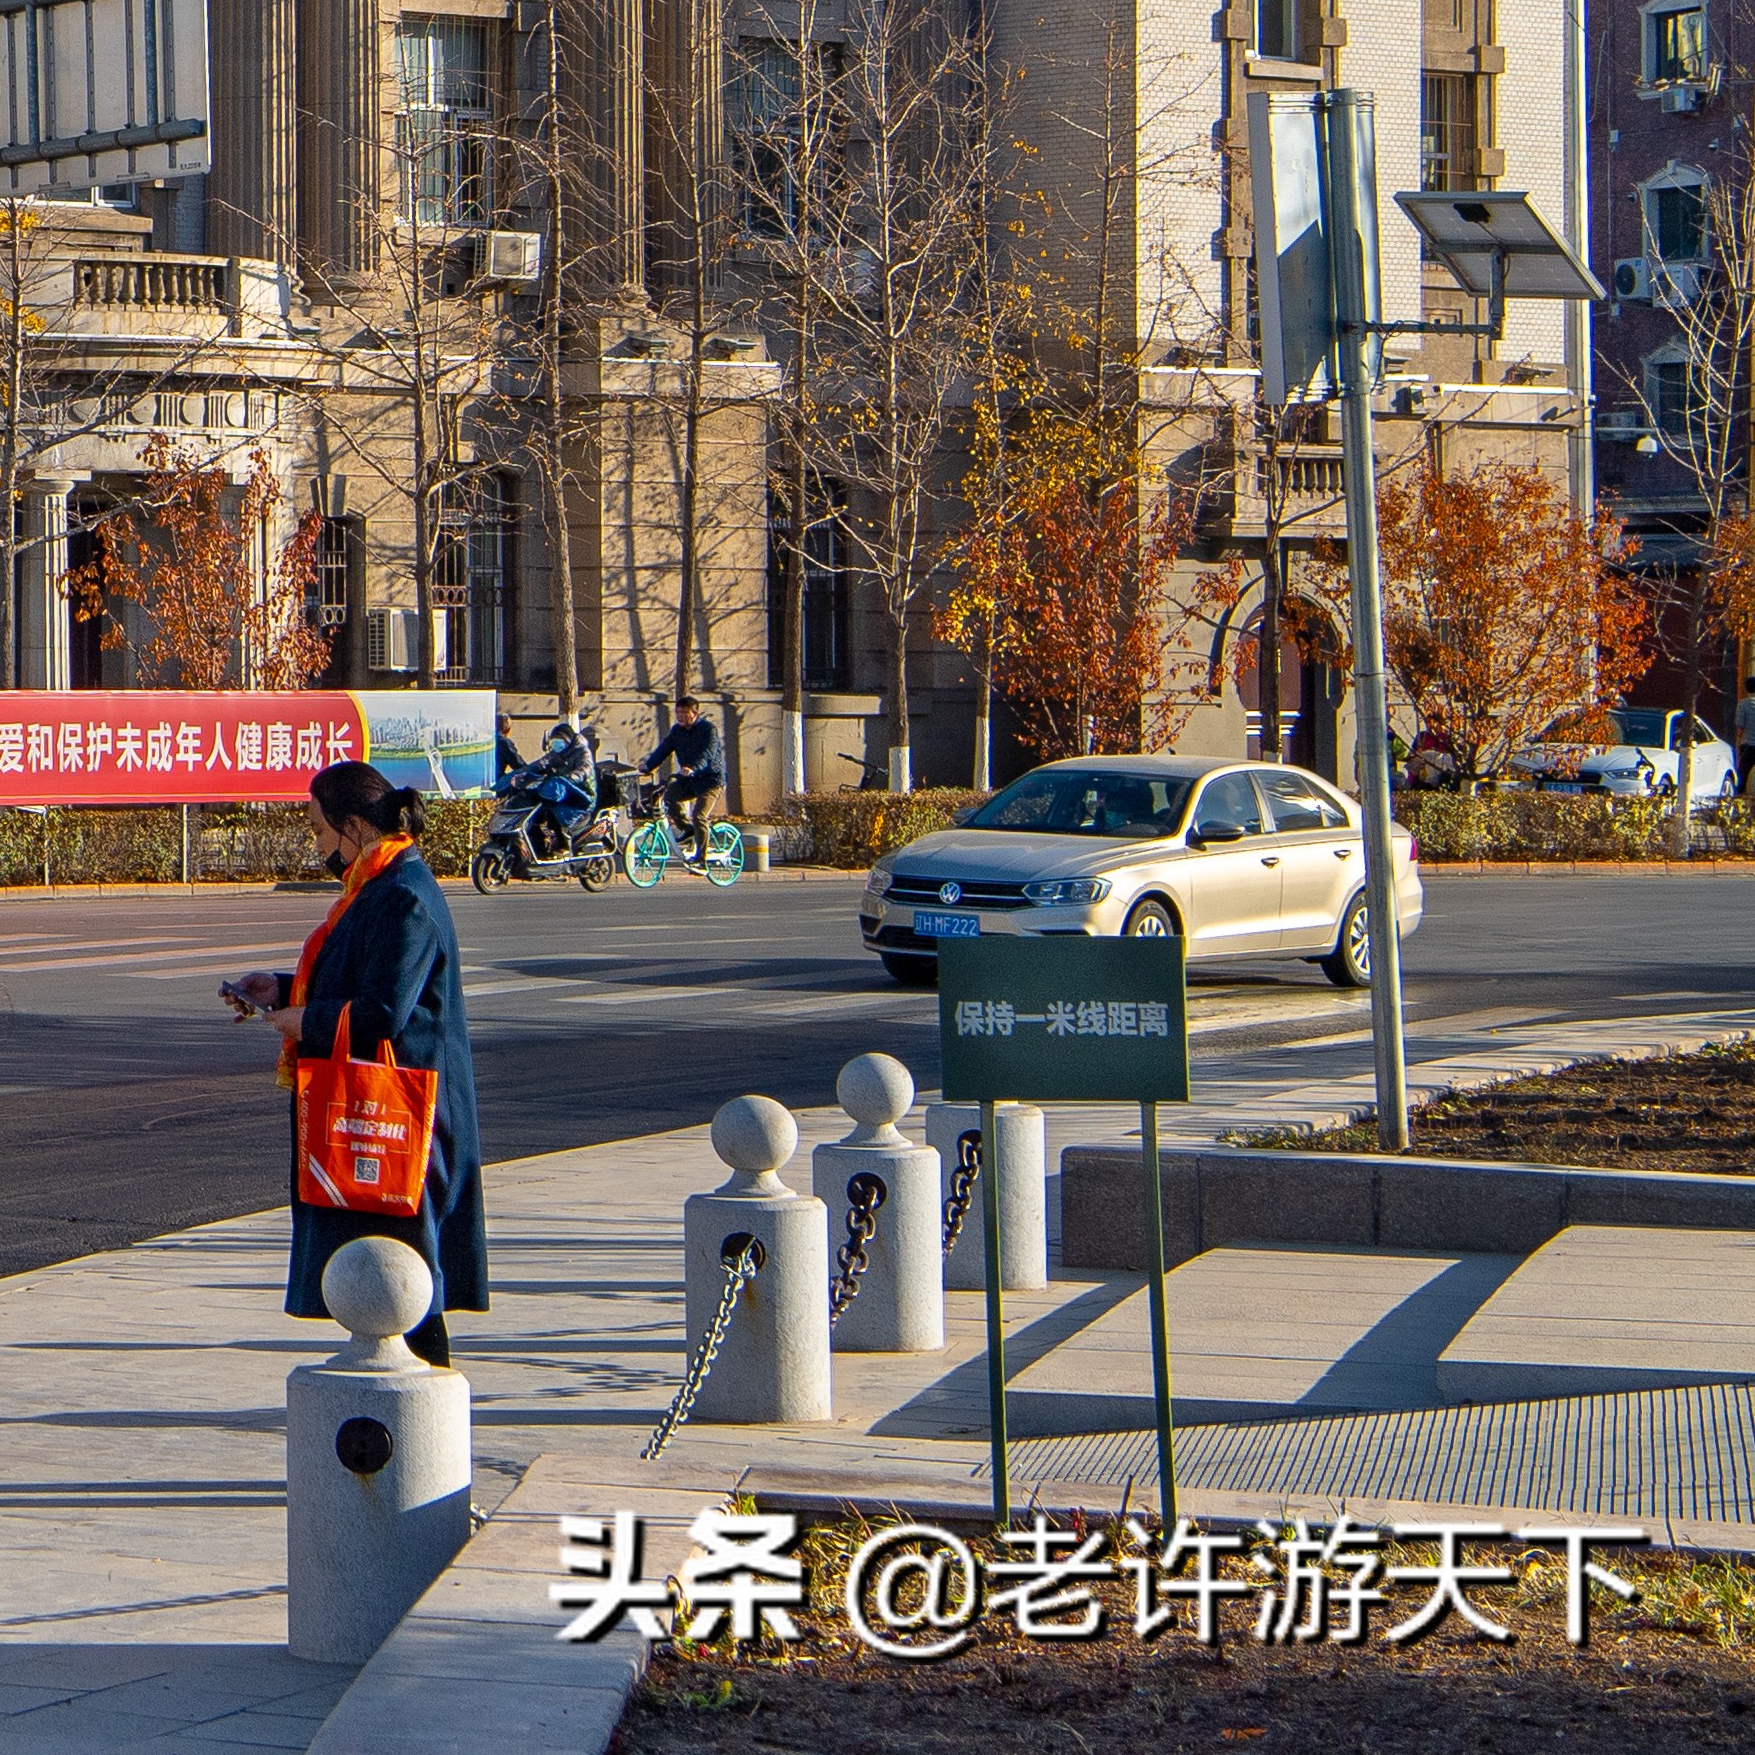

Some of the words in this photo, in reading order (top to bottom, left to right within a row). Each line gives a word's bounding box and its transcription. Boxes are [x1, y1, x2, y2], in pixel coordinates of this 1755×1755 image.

[954, 1000, 1170, 1037] 保持一米线距离
